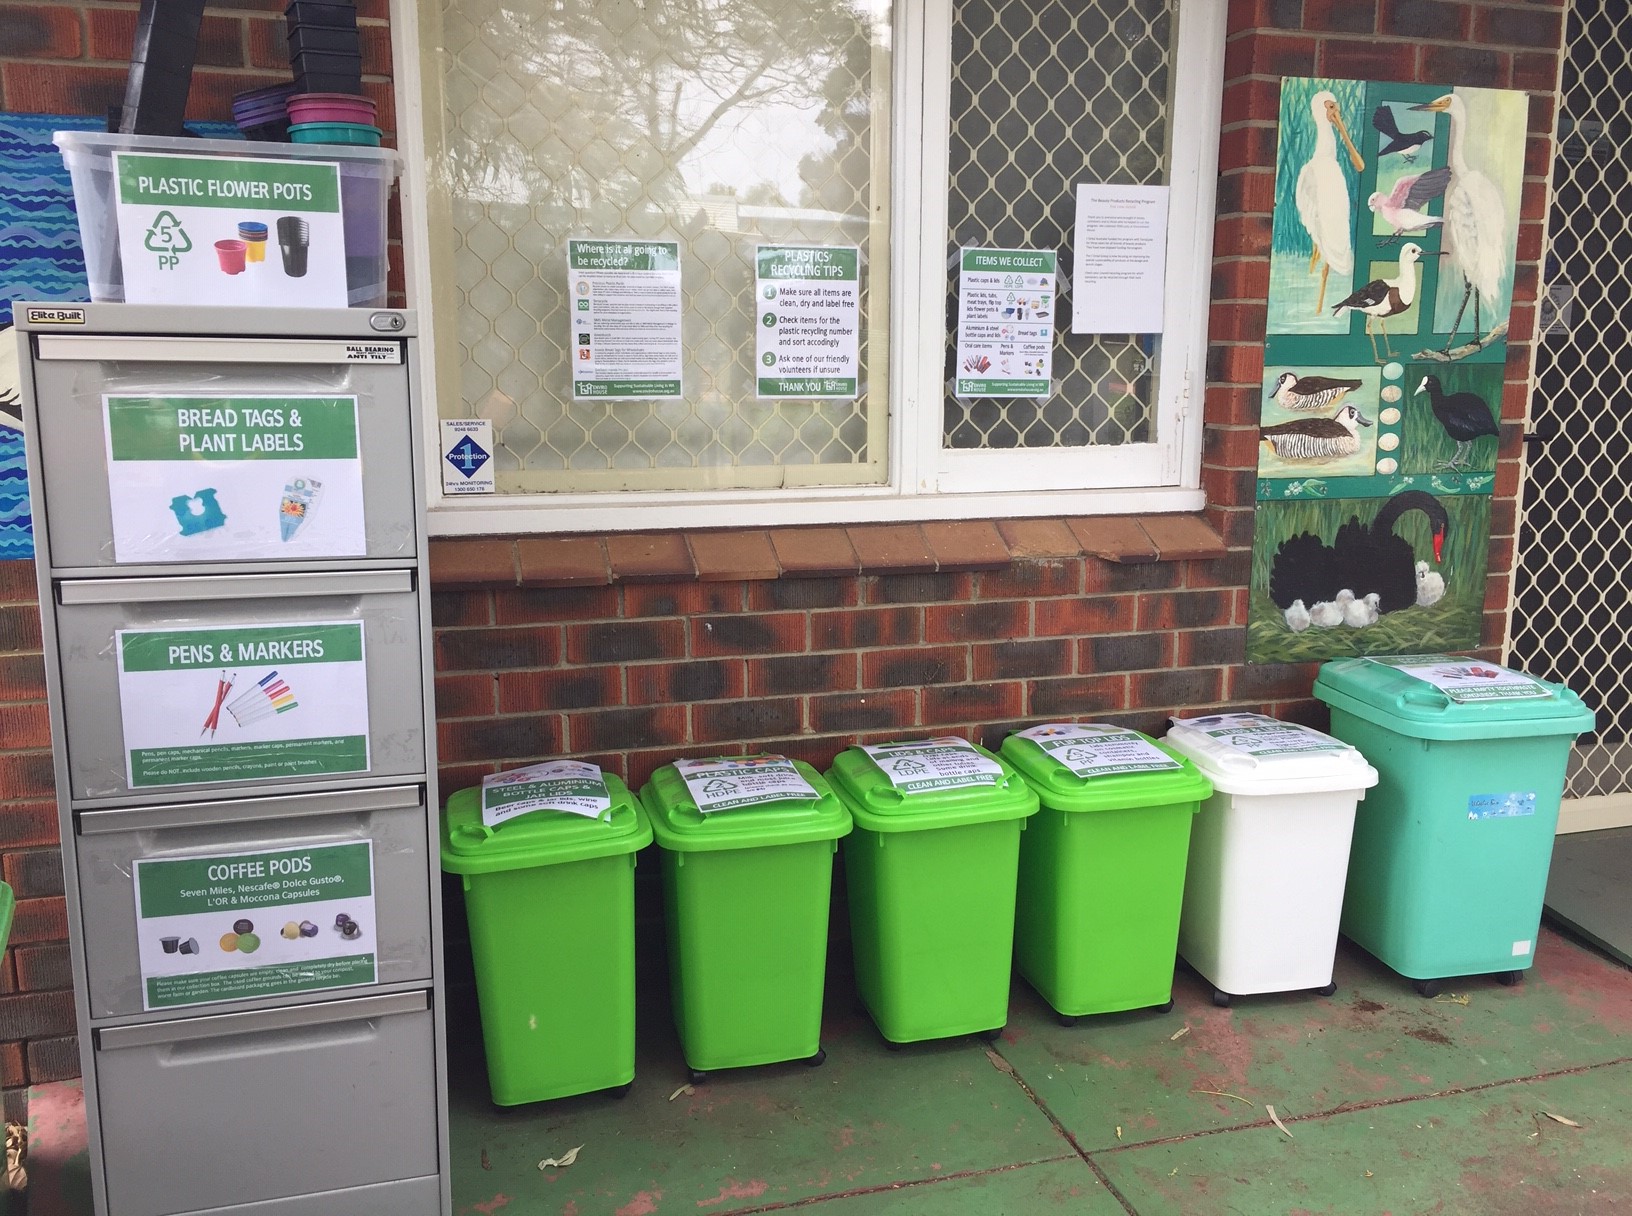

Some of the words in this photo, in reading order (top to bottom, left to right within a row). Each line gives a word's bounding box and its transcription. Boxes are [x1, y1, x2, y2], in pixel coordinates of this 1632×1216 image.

[138, 176, 203, 196] PLASTIC
[208, 178, 269, 199] FLOWER
[273, 182, 312, 201] POTS
[161, 226, 172, 243] 5
[577, 243, 604, 254] Where
[606, 244, 614, 254] is
[615, 244, 622, 254] it
[623, 245, 632, 254] all
[634, 245, 657, 257] going
[658, 246, 667, 255] to
[785, 250, 829, 262] PLASTICS
[158, 255, 180, 271] PP
[577, 256, 588, 266] be
[590, 257, 628, 268] recycled?
[976, 256, 997, 265] ITEMS
[999, 257, 1011, 266] WE
[1013, 257, 1043, 267] COLLECT
[771, 264, 820, 276] RECYCLING
[824, 265, 843, 277] TIPS
[767, 288, 772, 297] 1
[780, 288, 796, 296] Make
[822, 289, 840, 297] items
[800, 300, 810, 308] dry
[842, 300, 855, 308] free
[31, 311, 55, 320] Elite
[57, 312, 81, 320] Built
[780, 316, 798, 324] Check
[799, 316, 817, 324] items
[766, 316, 772, 325] 2
[779, 327, 799, 336] plastic
[801, 327, 827, 336] recycling
[778, 338, 791, 346] and
[765, 355, 772, 364] 3
[805, 355, 812, 363] of
[826, 355, 850, 364] friendly
[779, 382, 804, 392] THANK
[805, 382, 821, 392] YOU
[178, 409, 238, 428] BREAD
[242, 409, 284, 428] TAGS
[290, 409, 302, 427] &
[180, 434, 236, 452] PLANT
[242, 433, 304, 452] LABELS
[169, 645, 214, 665] PENS
[219, 644, 233, 662] &
[238, 640, 324, 661] MARKERS
[1052, 739, 1076, 747] FLIP
[696, 769, 752, 778] PLASTIC
[898, 768, 930, 776] LDPE
[1086, 766, 1111, 774] CLEAN
[492, 785, 525, 794] STEEL
[907, 781, 933, 790] CLEAN
[503, 788, 546, 797] BOTTLE
[706, 789, 742, 799] HDPE
[712, 800, 739, 808] CLEAN
[495, 808, 511, 816] and
[207, 861, 265, 881] COFFEE
[269, 856, 312, 876] PODS
[180, 888, 207, 898] Seven
[210, 885, 236, 896] Miles,
[282, 878, 307, 889] Dolce
[207, 896, 228, 907] L'OR
[231, 896, 238, 904] &
[240, 892, 280, 903] Moccona
[282, 888, 320, 900] Capsules
